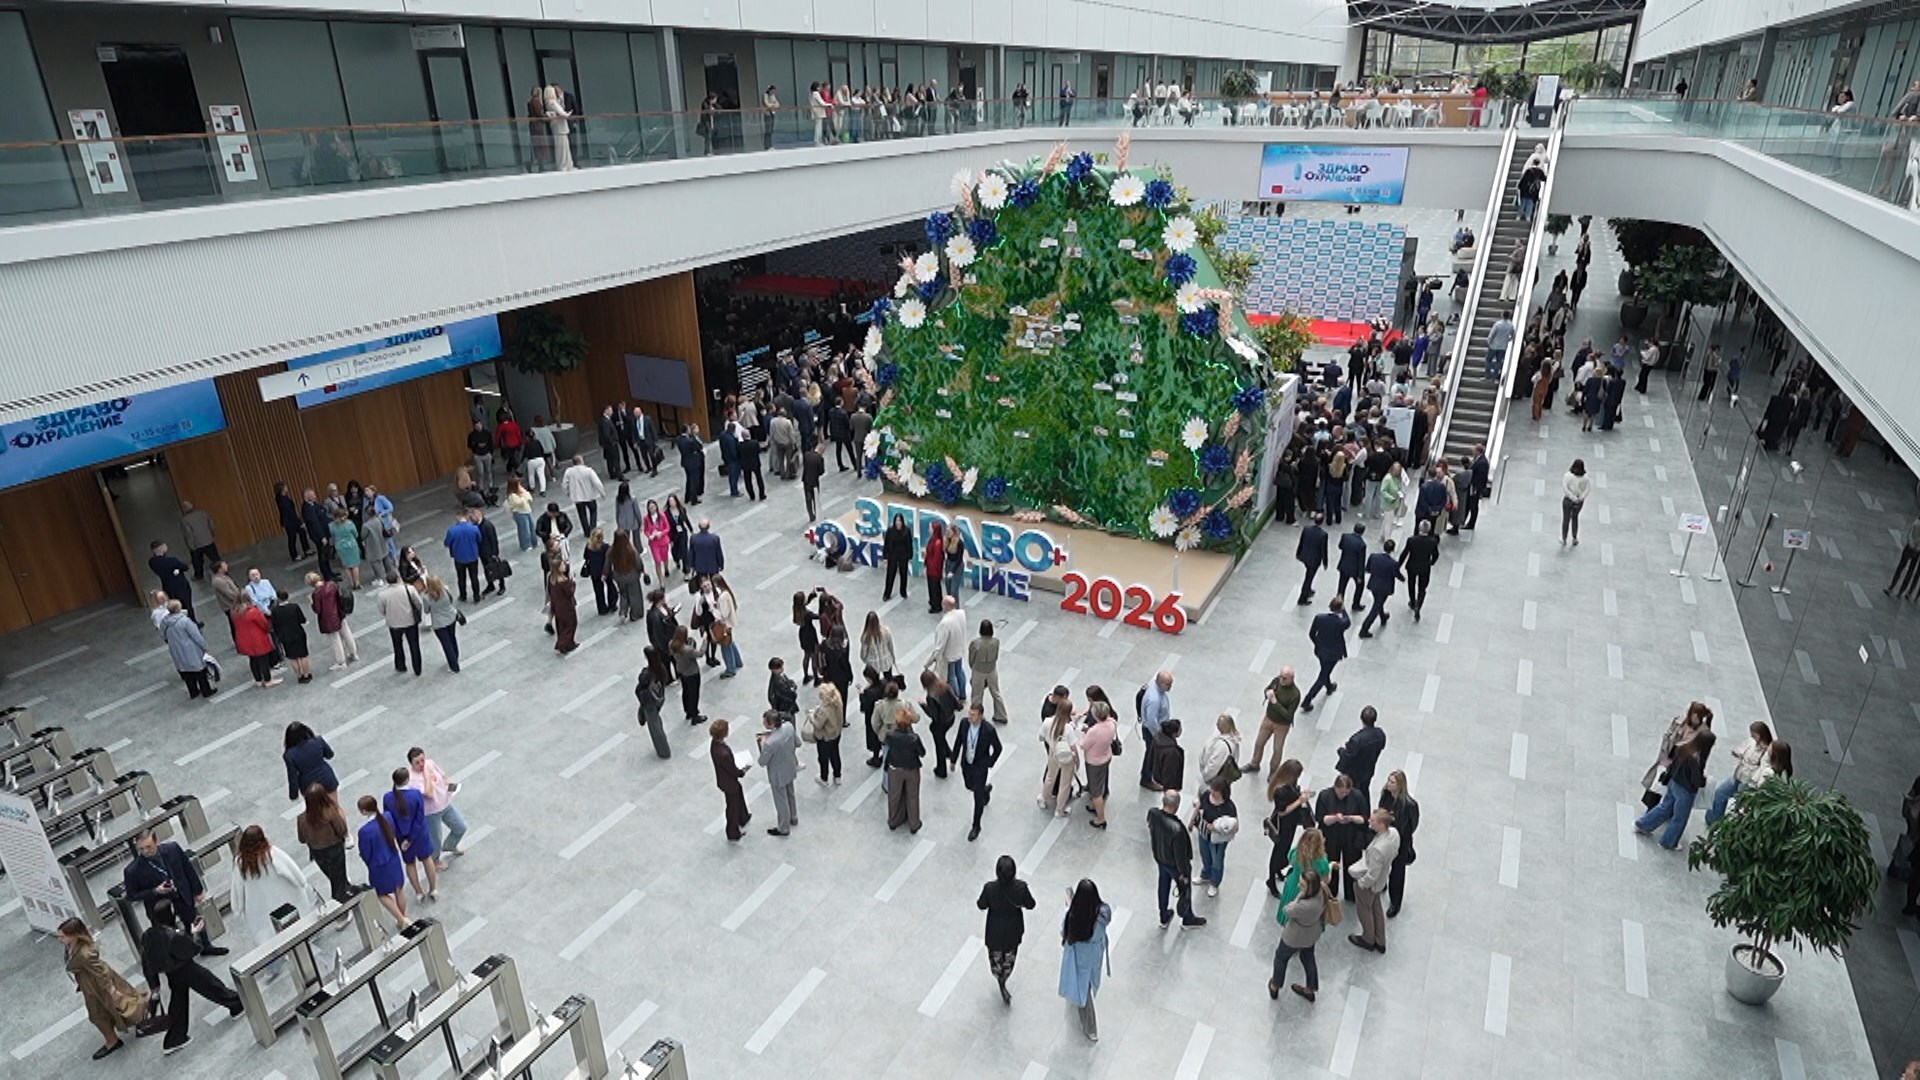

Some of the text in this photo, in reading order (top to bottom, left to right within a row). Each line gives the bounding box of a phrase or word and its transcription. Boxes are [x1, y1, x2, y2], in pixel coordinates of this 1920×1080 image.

[14, 413, 123, 448] ОХРАНЕНИЕ
[34, 396, 128, 432] ЗДРАВО
[1060, 571, 1187, 635] 2026
